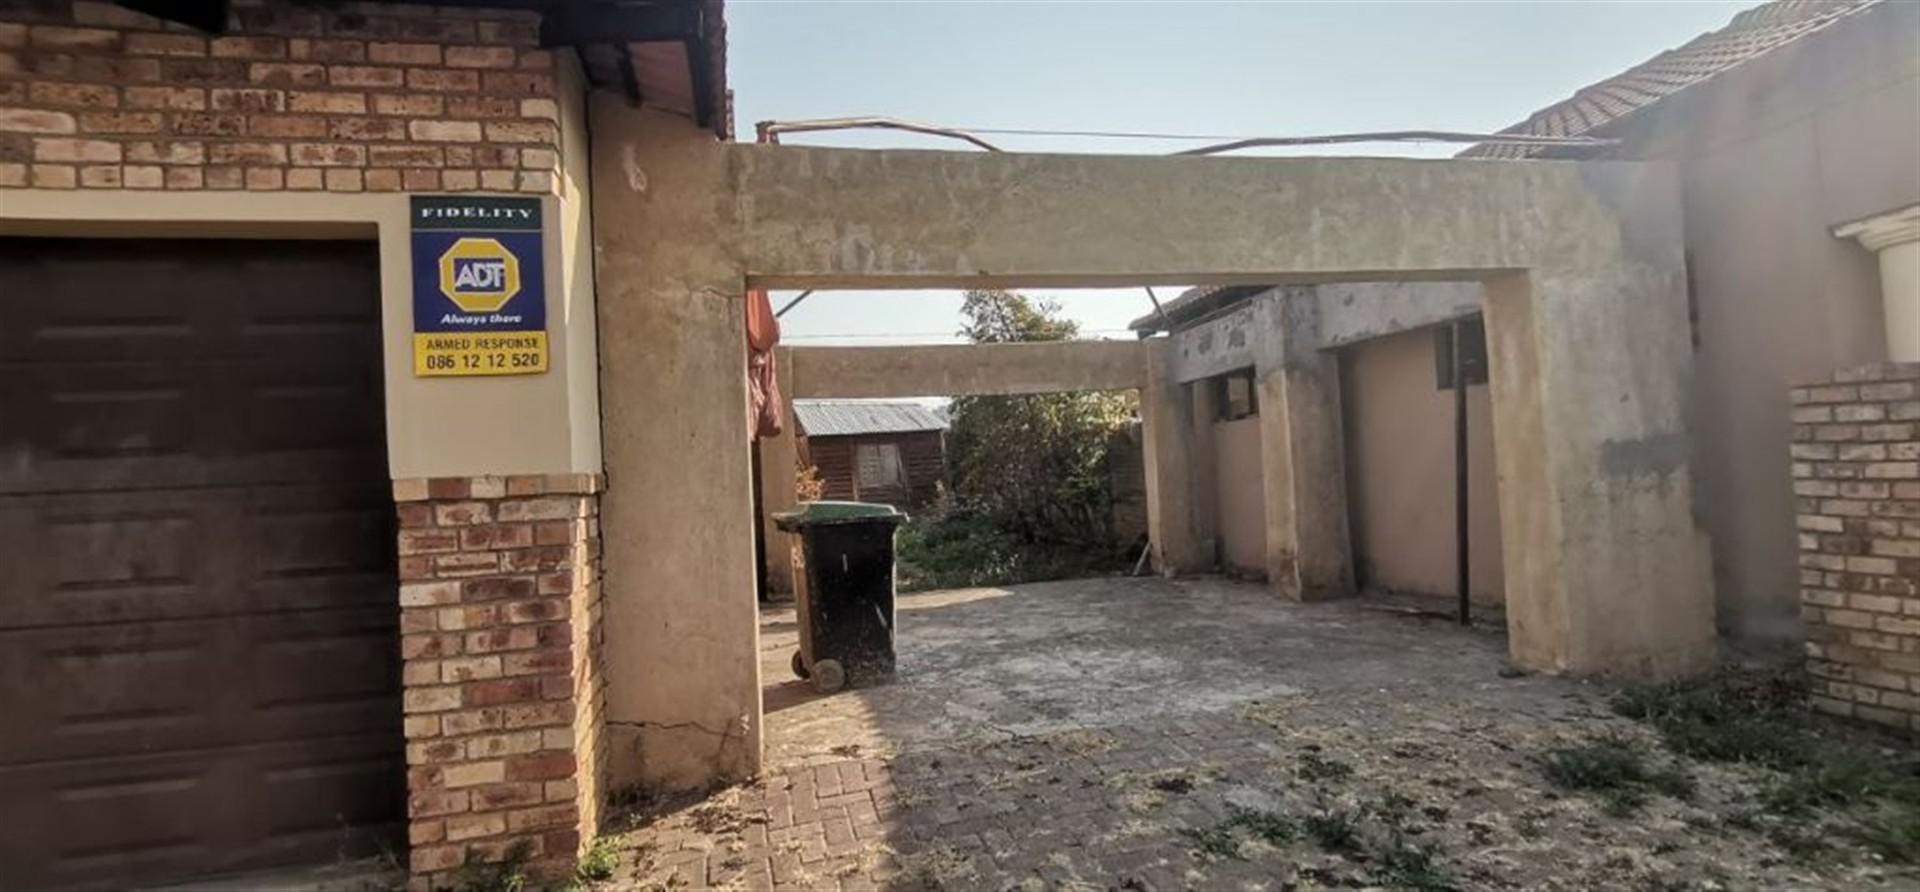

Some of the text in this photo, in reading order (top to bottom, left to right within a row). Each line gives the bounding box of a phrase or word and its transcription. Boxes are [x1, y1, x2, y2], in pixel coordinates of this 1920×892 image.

[421, 207, 533, 219] FIDELITY
[455, 262, 505, 288] ADT
[441, 314, 522, 325] Always there
[426, 337, 539, 350] ARMED RESPONSE
[426, 352, 539, 369] 086 12 12 520
